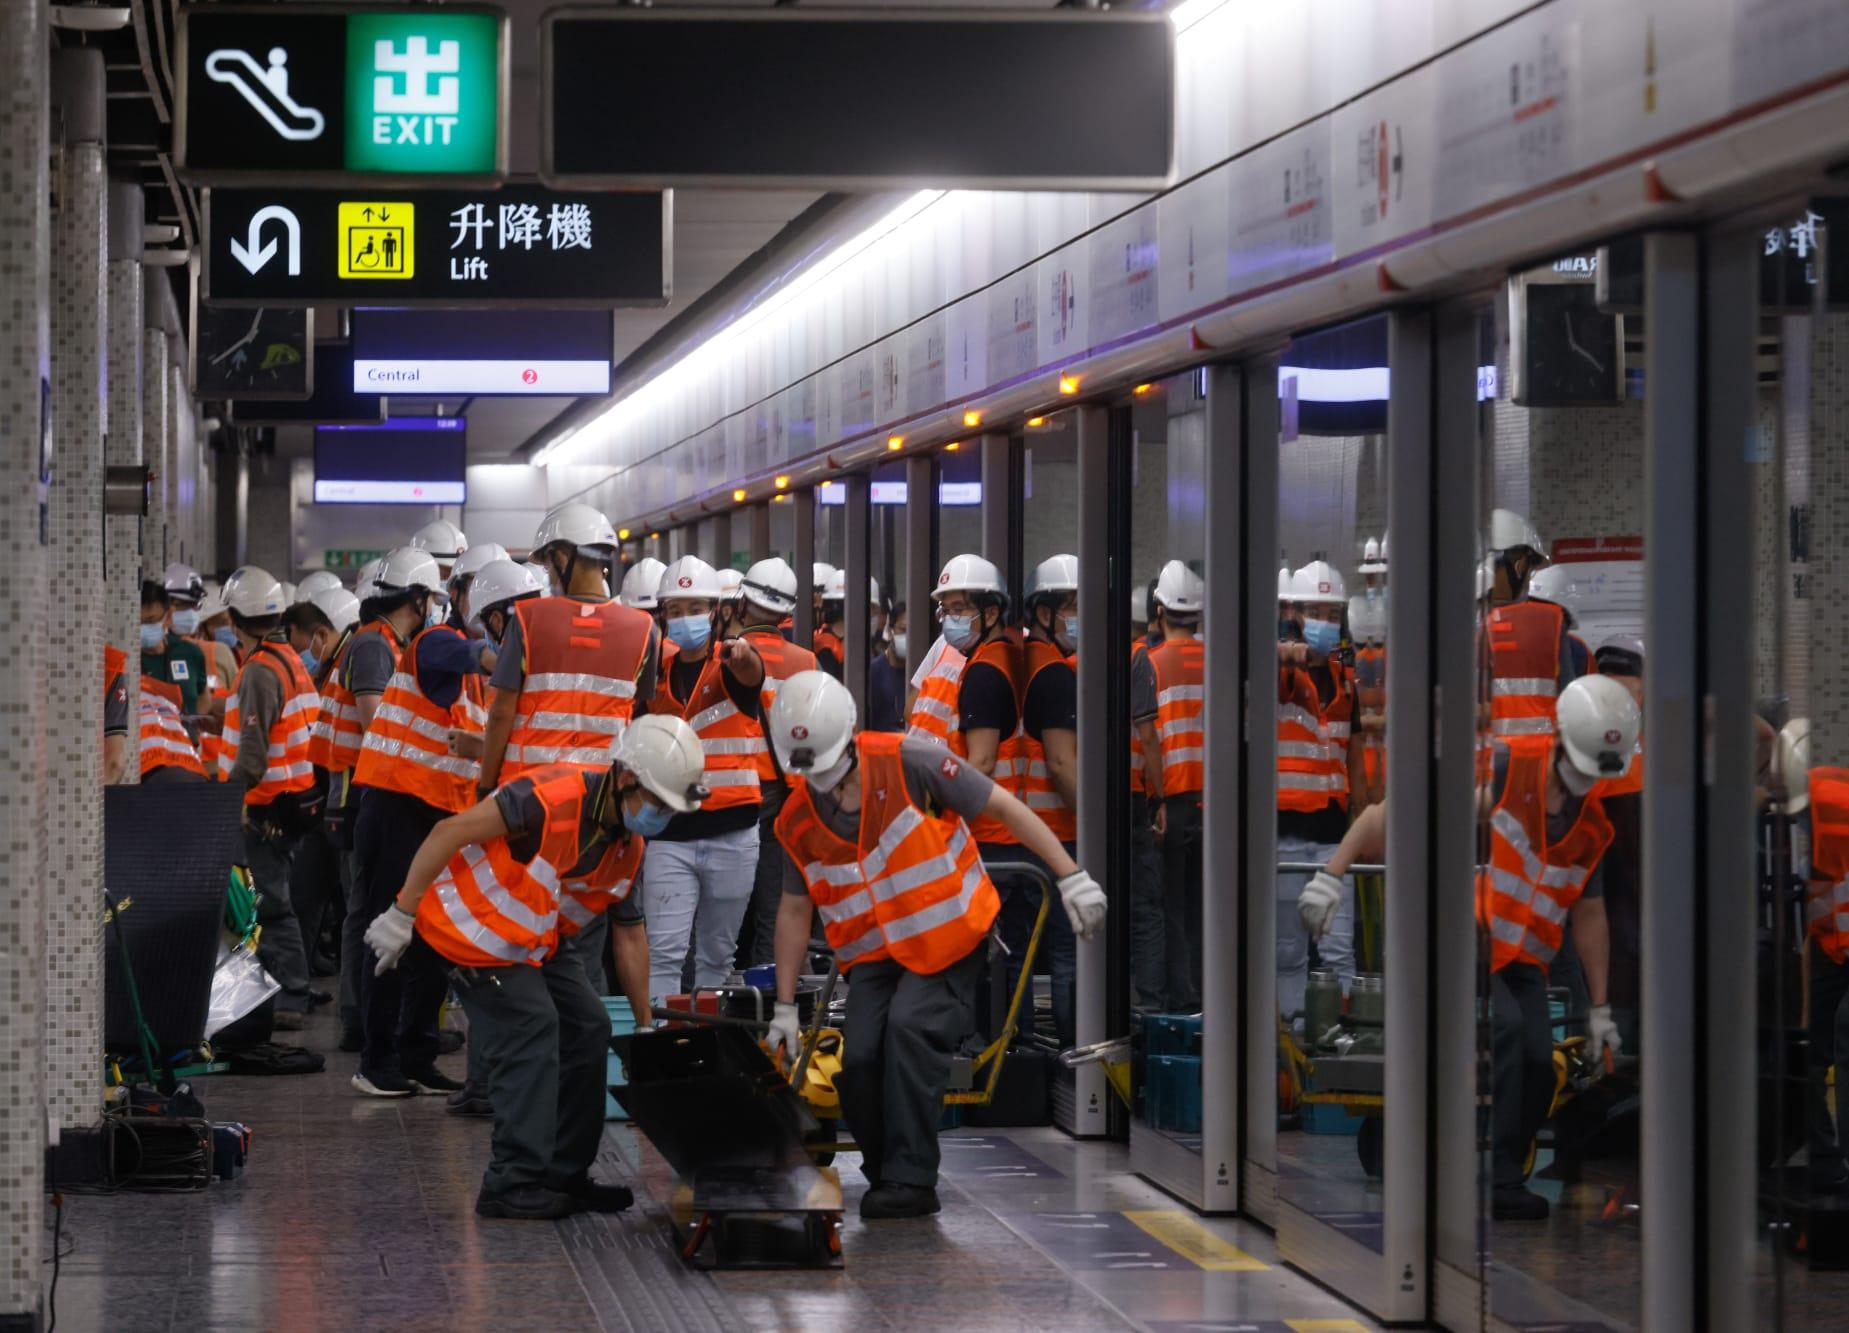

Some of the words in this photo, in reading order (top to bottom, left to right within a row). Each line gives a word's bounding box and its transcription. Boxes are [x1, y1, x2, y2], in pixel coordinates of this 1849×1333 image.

[374, 36, 459, 113] 出
[373, 116, 459, 145] EXIT
[449, 203, 593, 250] 升降機
[450, 257, 489, 280] Lift
[367, 368, 420, 382] Central
